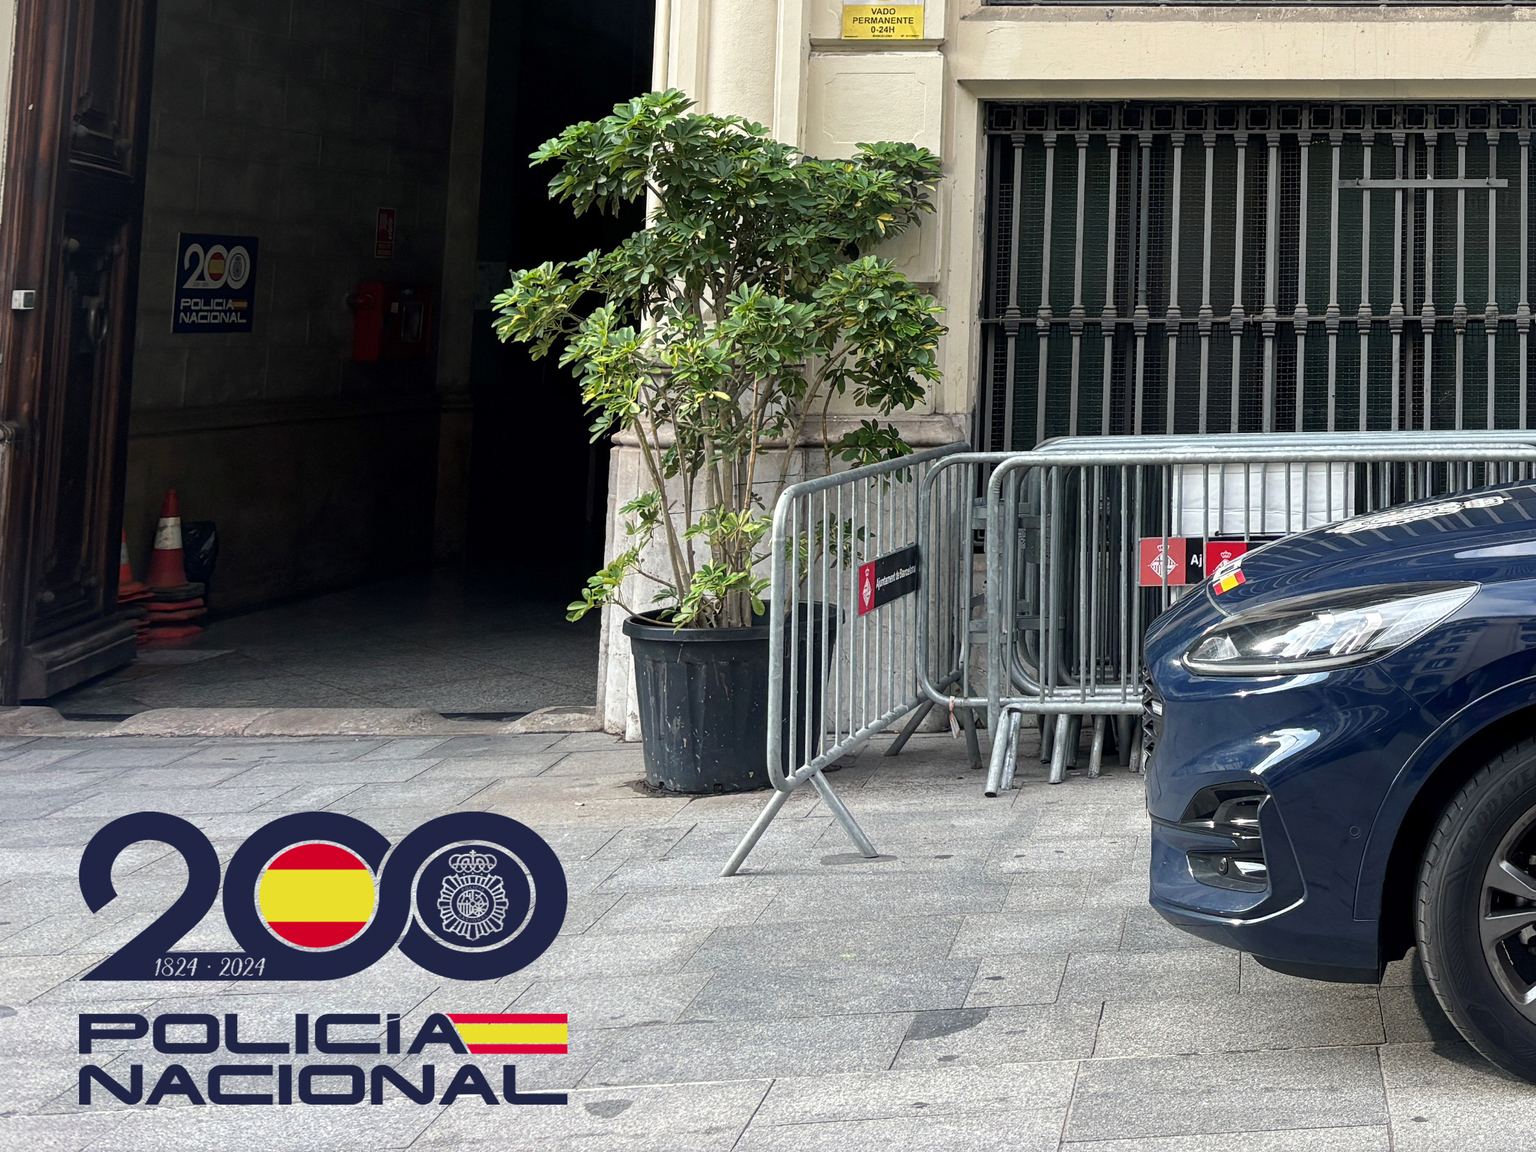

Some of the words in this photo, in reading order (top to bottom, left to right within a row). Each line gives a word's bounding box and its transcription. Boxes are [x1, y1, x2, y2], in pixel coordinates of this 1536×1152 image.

[852, 17, 915, 25] PERMANENTE
[870, 26, 895, 34] 0-24H
[182, 243, 251, 290] 200
[179, 311, 247, 324] NACIONAL
